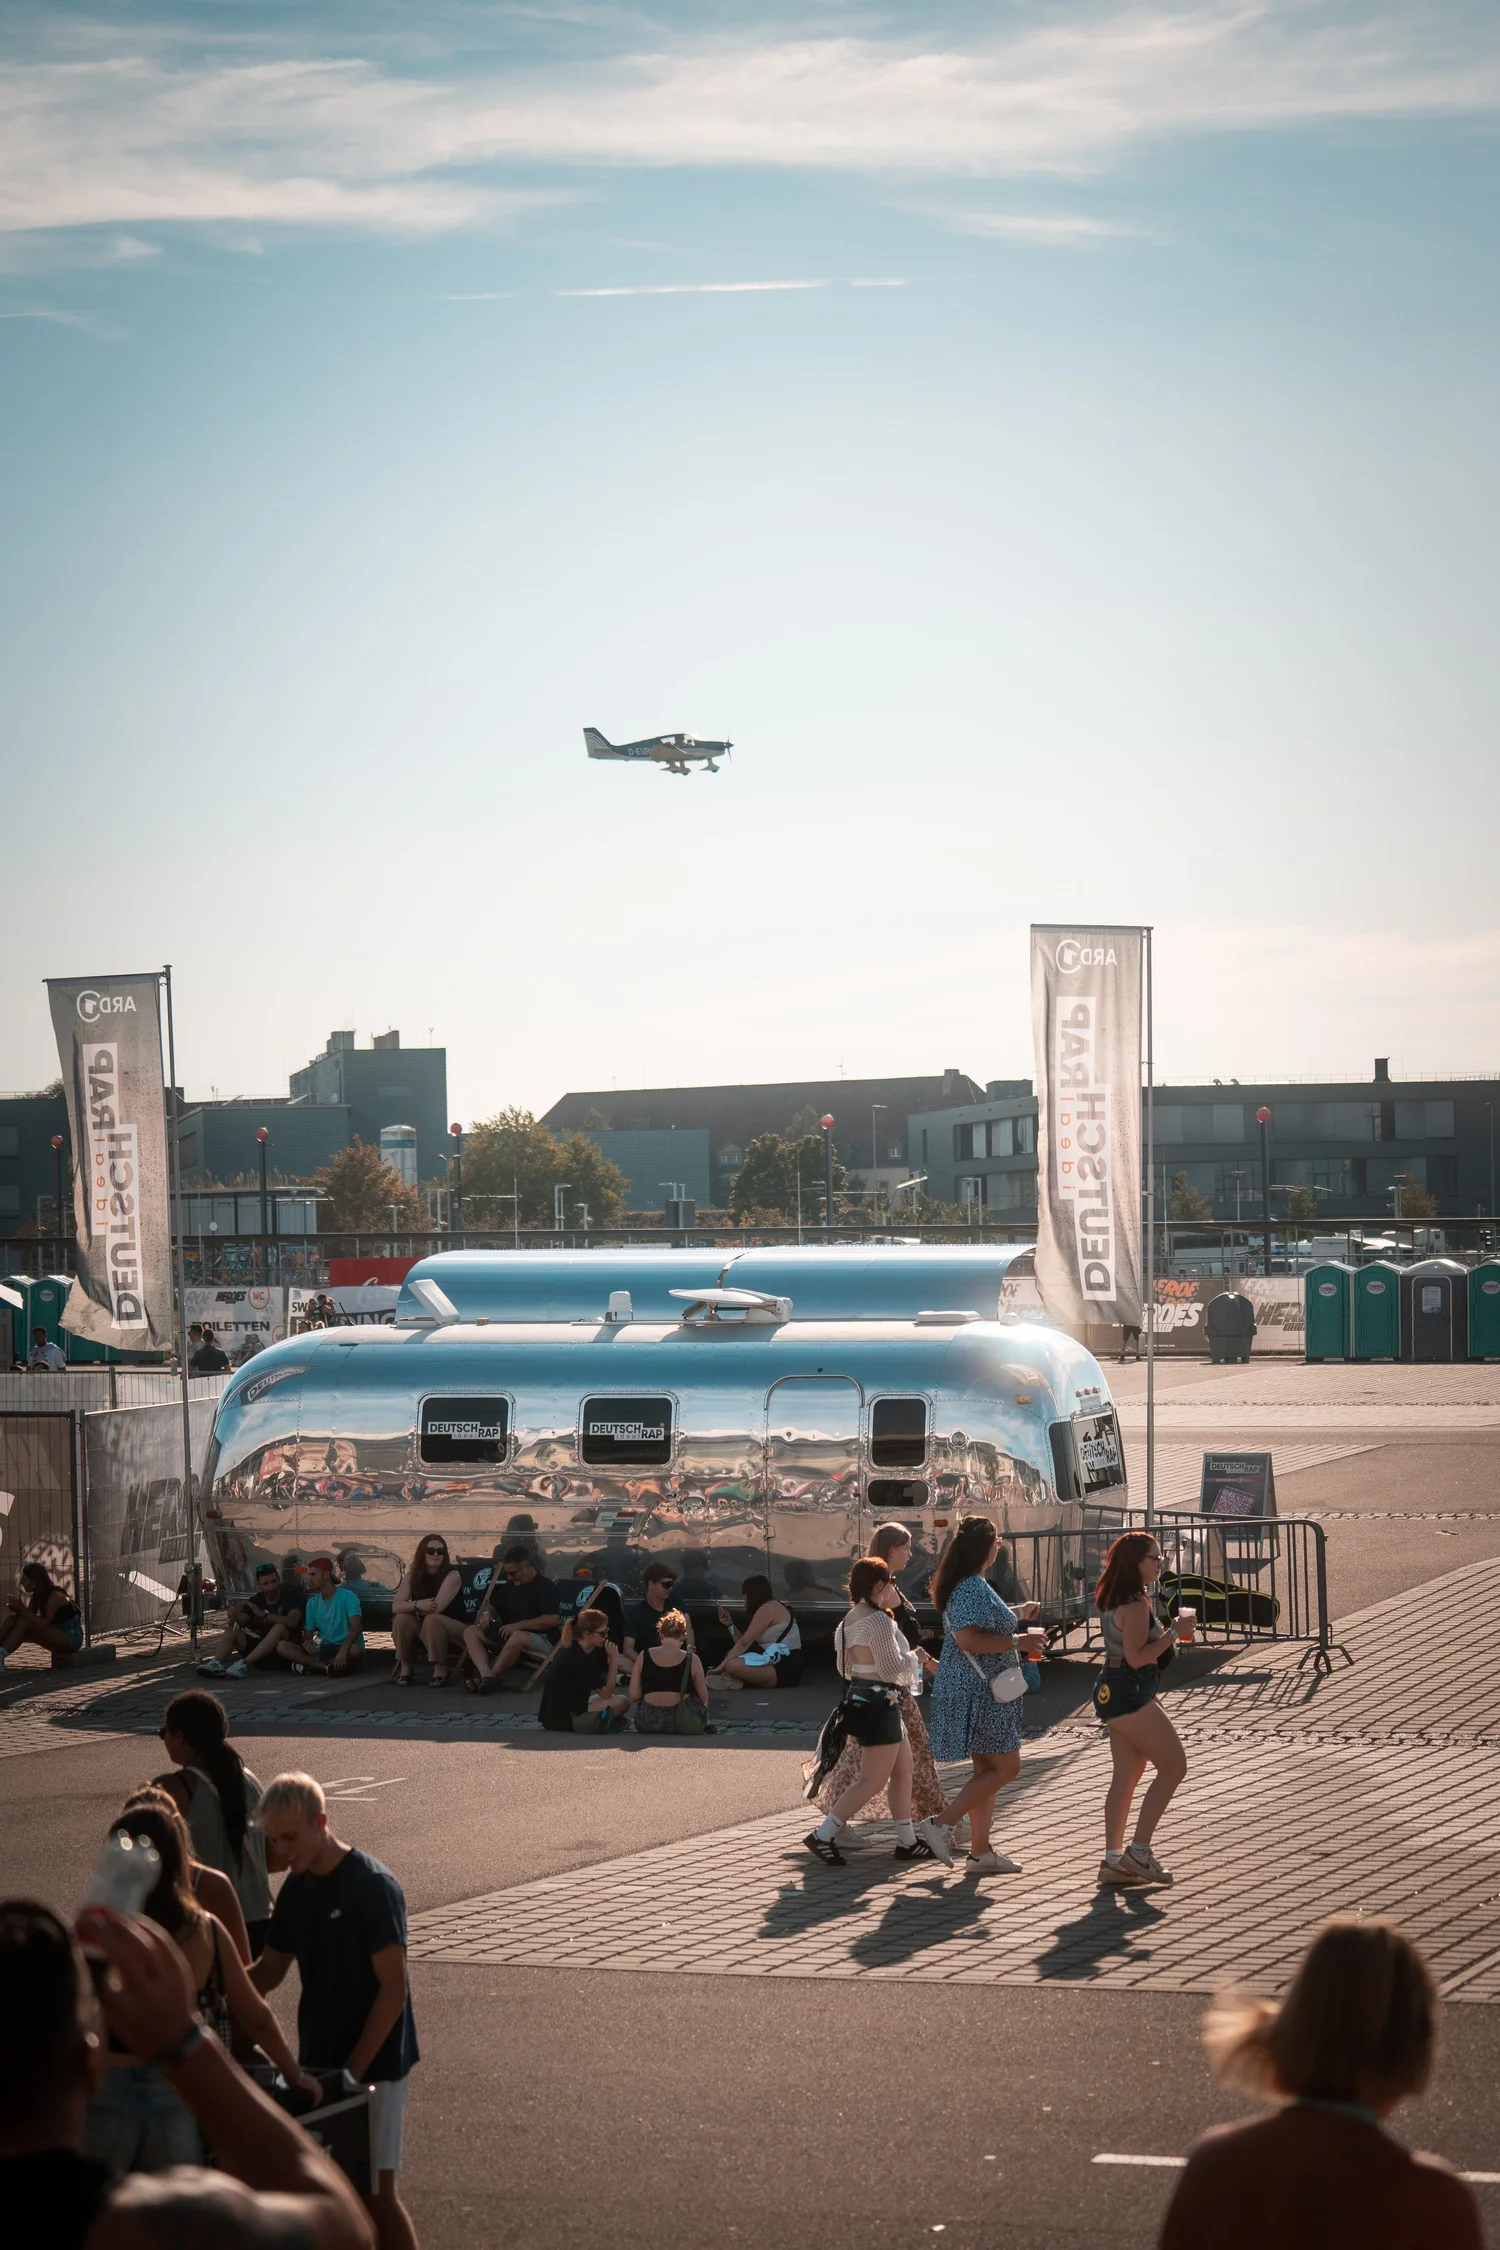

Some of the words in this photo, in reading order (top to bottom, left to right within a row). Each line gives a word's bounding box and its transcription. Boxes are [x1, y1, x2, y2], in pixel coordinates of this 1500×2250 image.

[215, 1291, 247, 1302] HEROES
[253, 1292, 265, 1301] WC
[1142, 1302, 1205, 1327] ROES
[1255, 1302, 1306, 1326] HER
[430, 1423, 478, 1433] DEUTSCH
[478, 1428, 499, 1438] RAP
[592, 1424, 641, 1434] DEUTSCH
[641, 1429, 663, 1439] RAP
[120, 1474, 201, 1557] HERO
